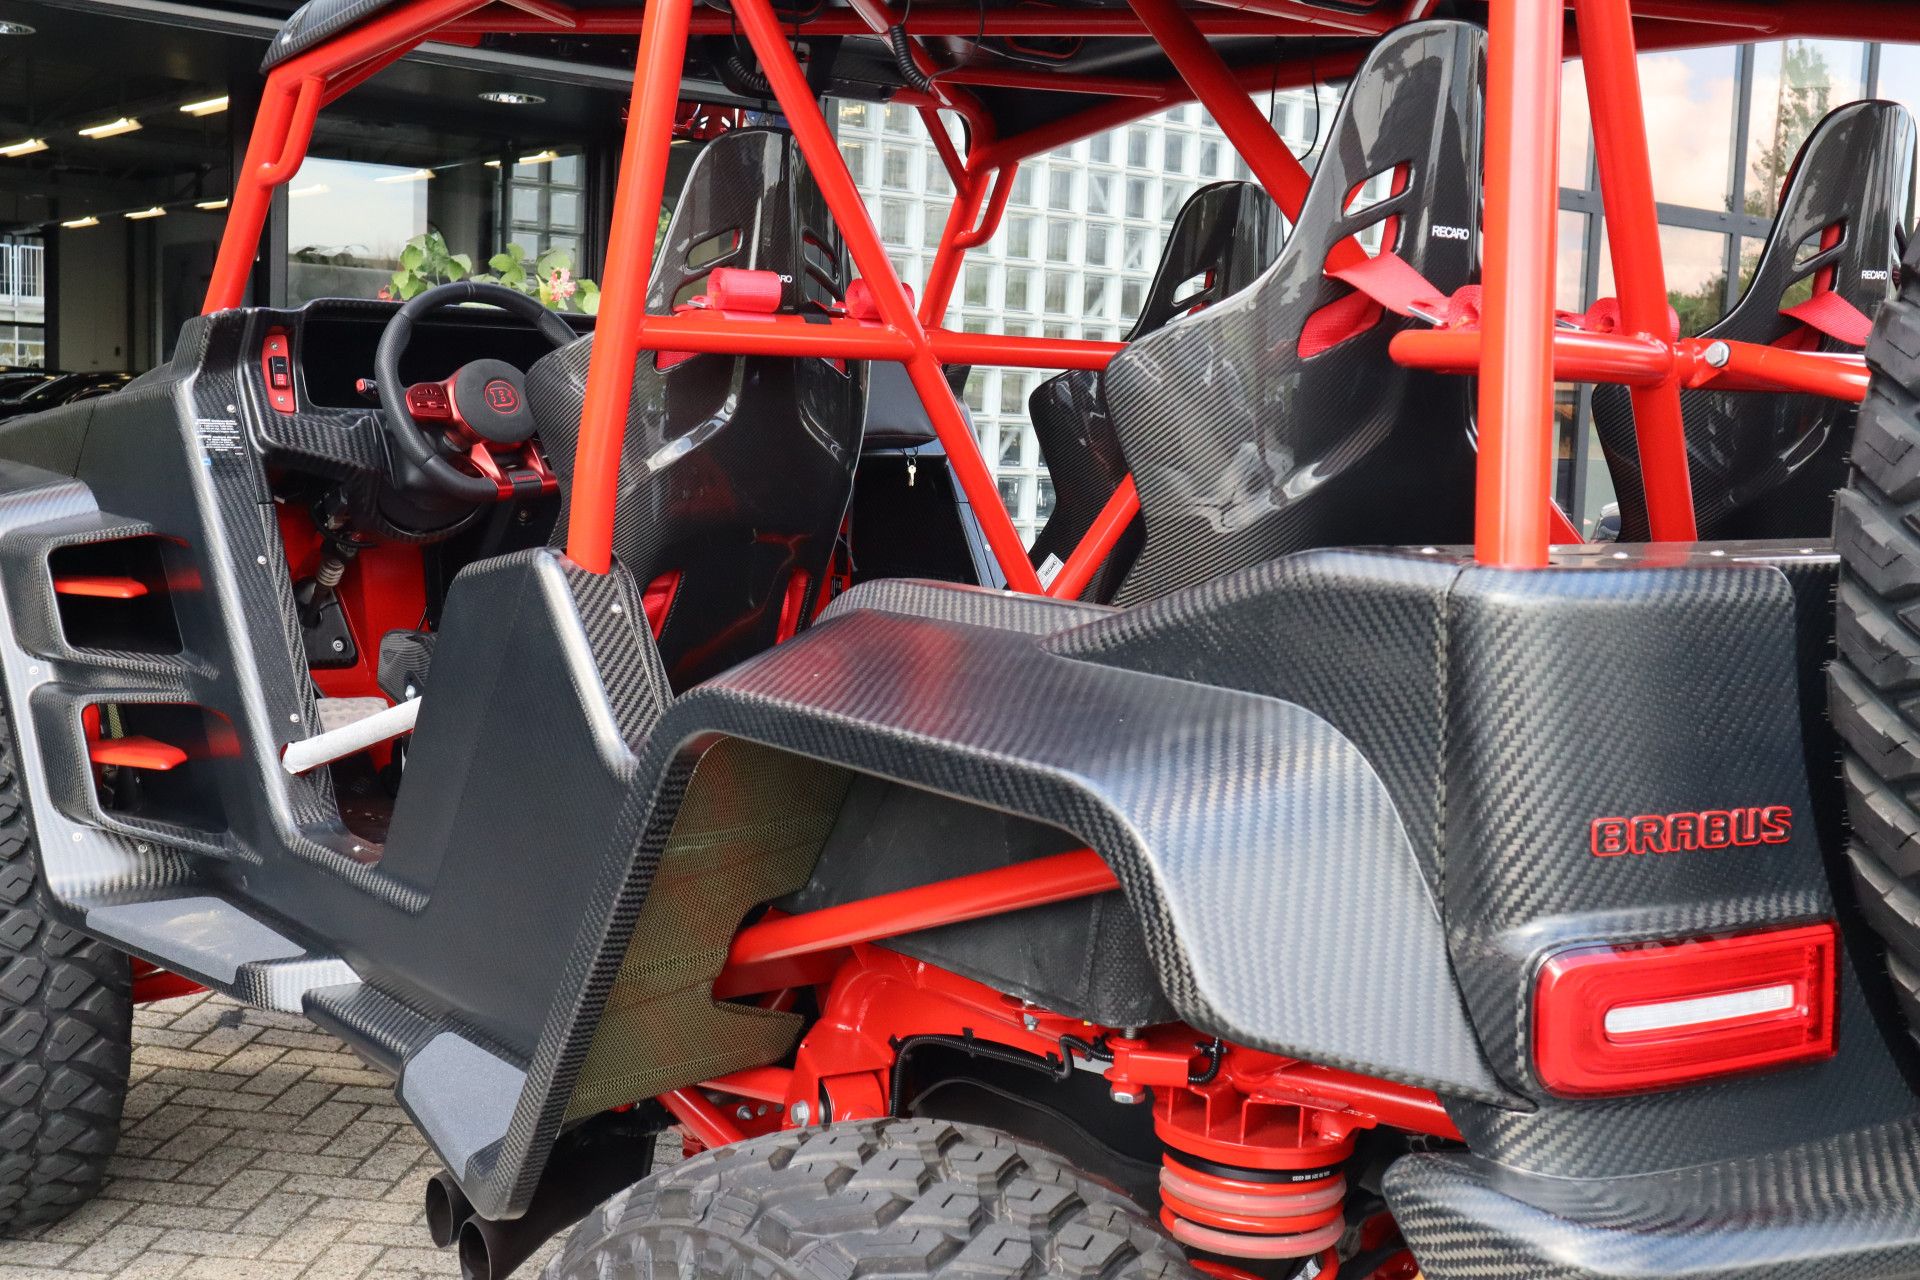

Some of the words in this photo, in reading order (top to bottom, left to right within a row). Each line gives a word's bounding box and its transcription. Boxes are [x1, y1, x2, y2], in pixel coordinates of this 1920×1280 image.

[1431, 225, 1470, 240] RECARO
[1861, 269, 1888, 280] RECARO
[1591, 806, 1793, 857] BRABUS
